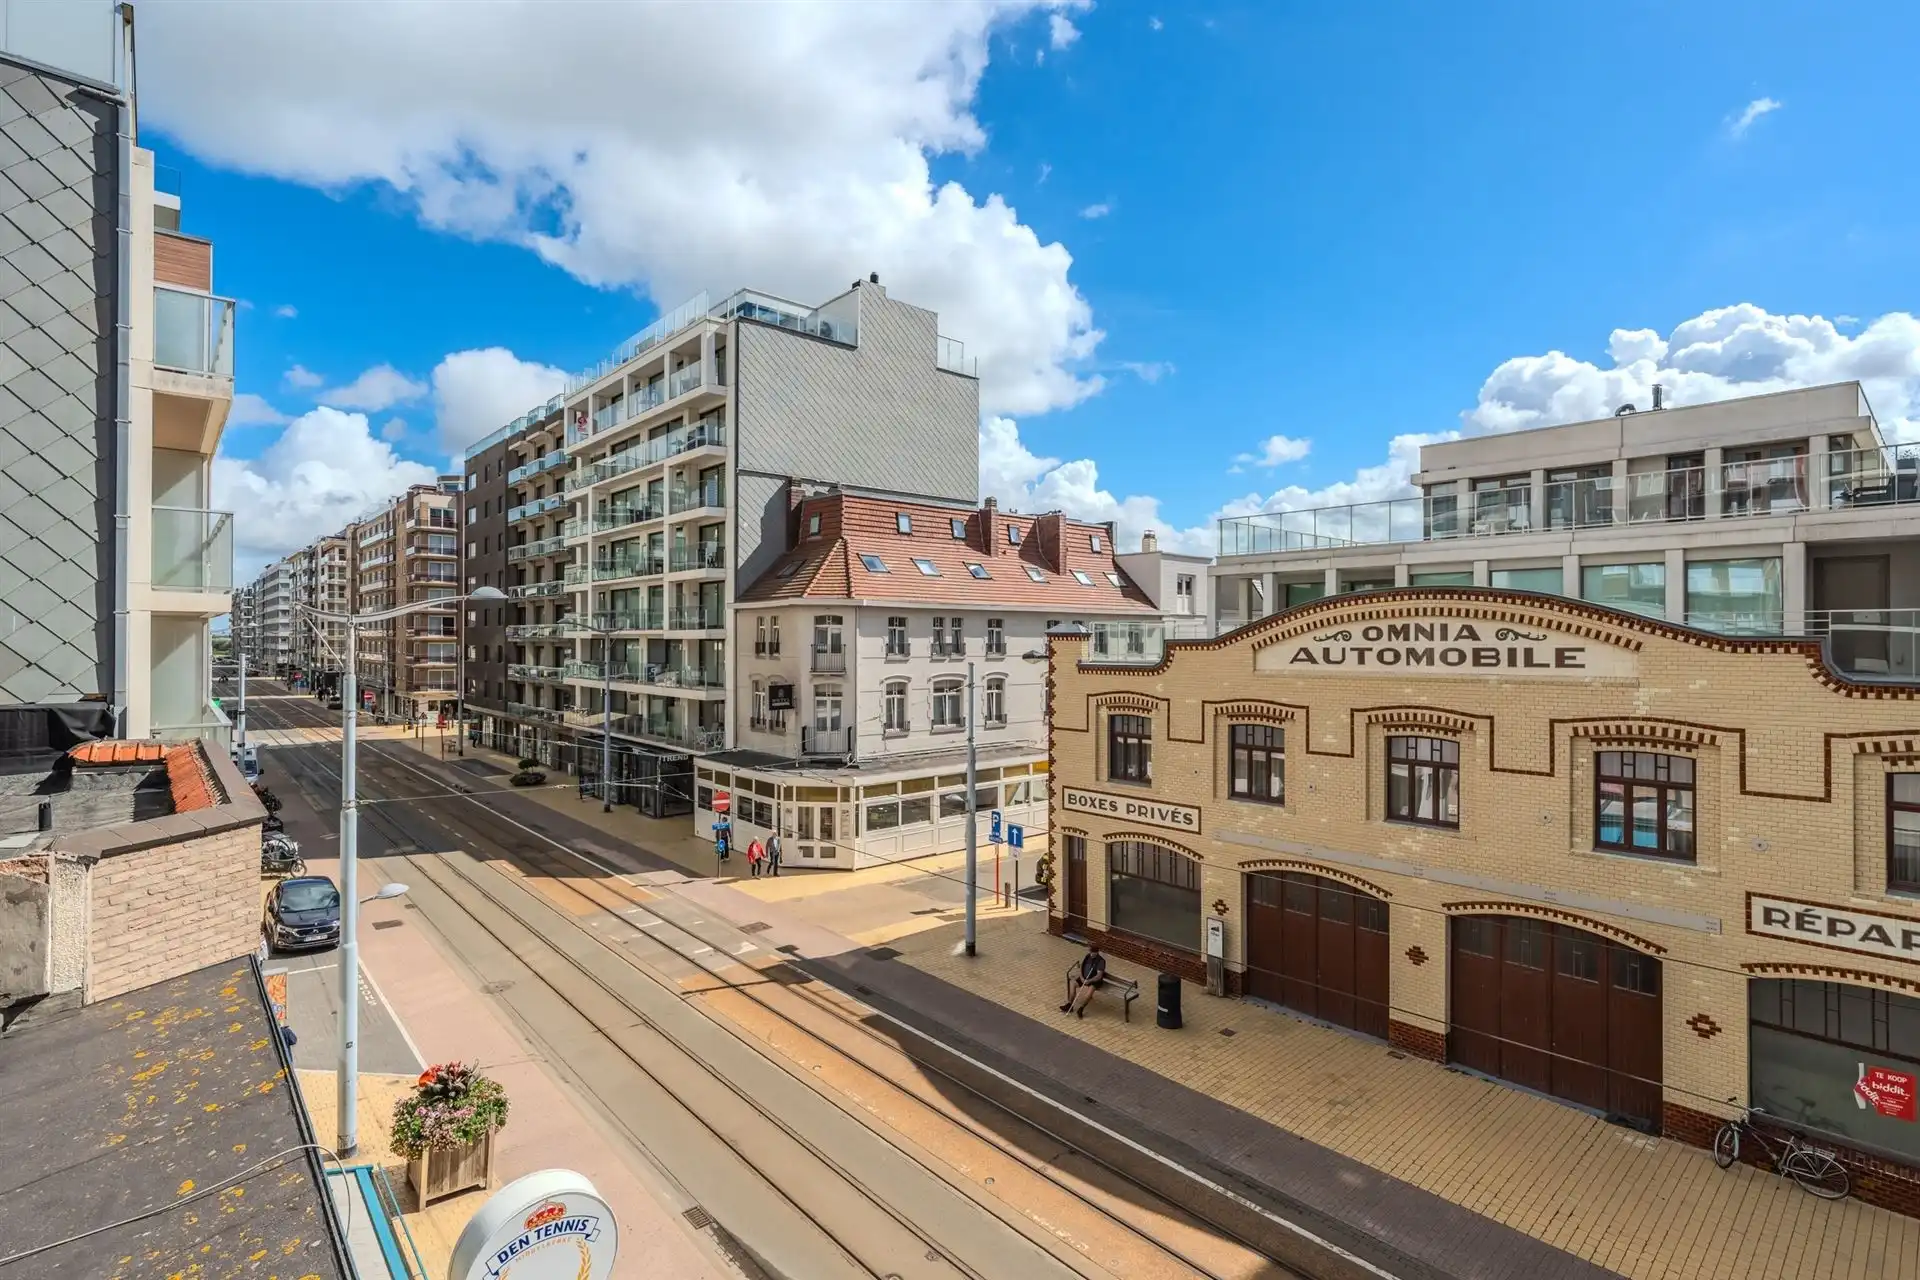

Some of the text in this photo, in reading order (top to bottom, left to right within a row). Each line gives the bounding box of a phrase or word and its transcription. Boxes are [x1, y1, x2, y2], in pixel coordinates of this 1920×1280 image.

[1362, 623, 1481, 642] OMNIA
[1289, 647, 1586, 668] AUTOMOBILE
[661, 754, 689, 762] TREND
[1067, 793, 1194, 826] BOXES PRIVÉS
[992, 814, 1000, 828] P
[1874, 1071, 1908, 1084] TE KOOP
[497, 1218, 590, 1264] DEN TENNIS
